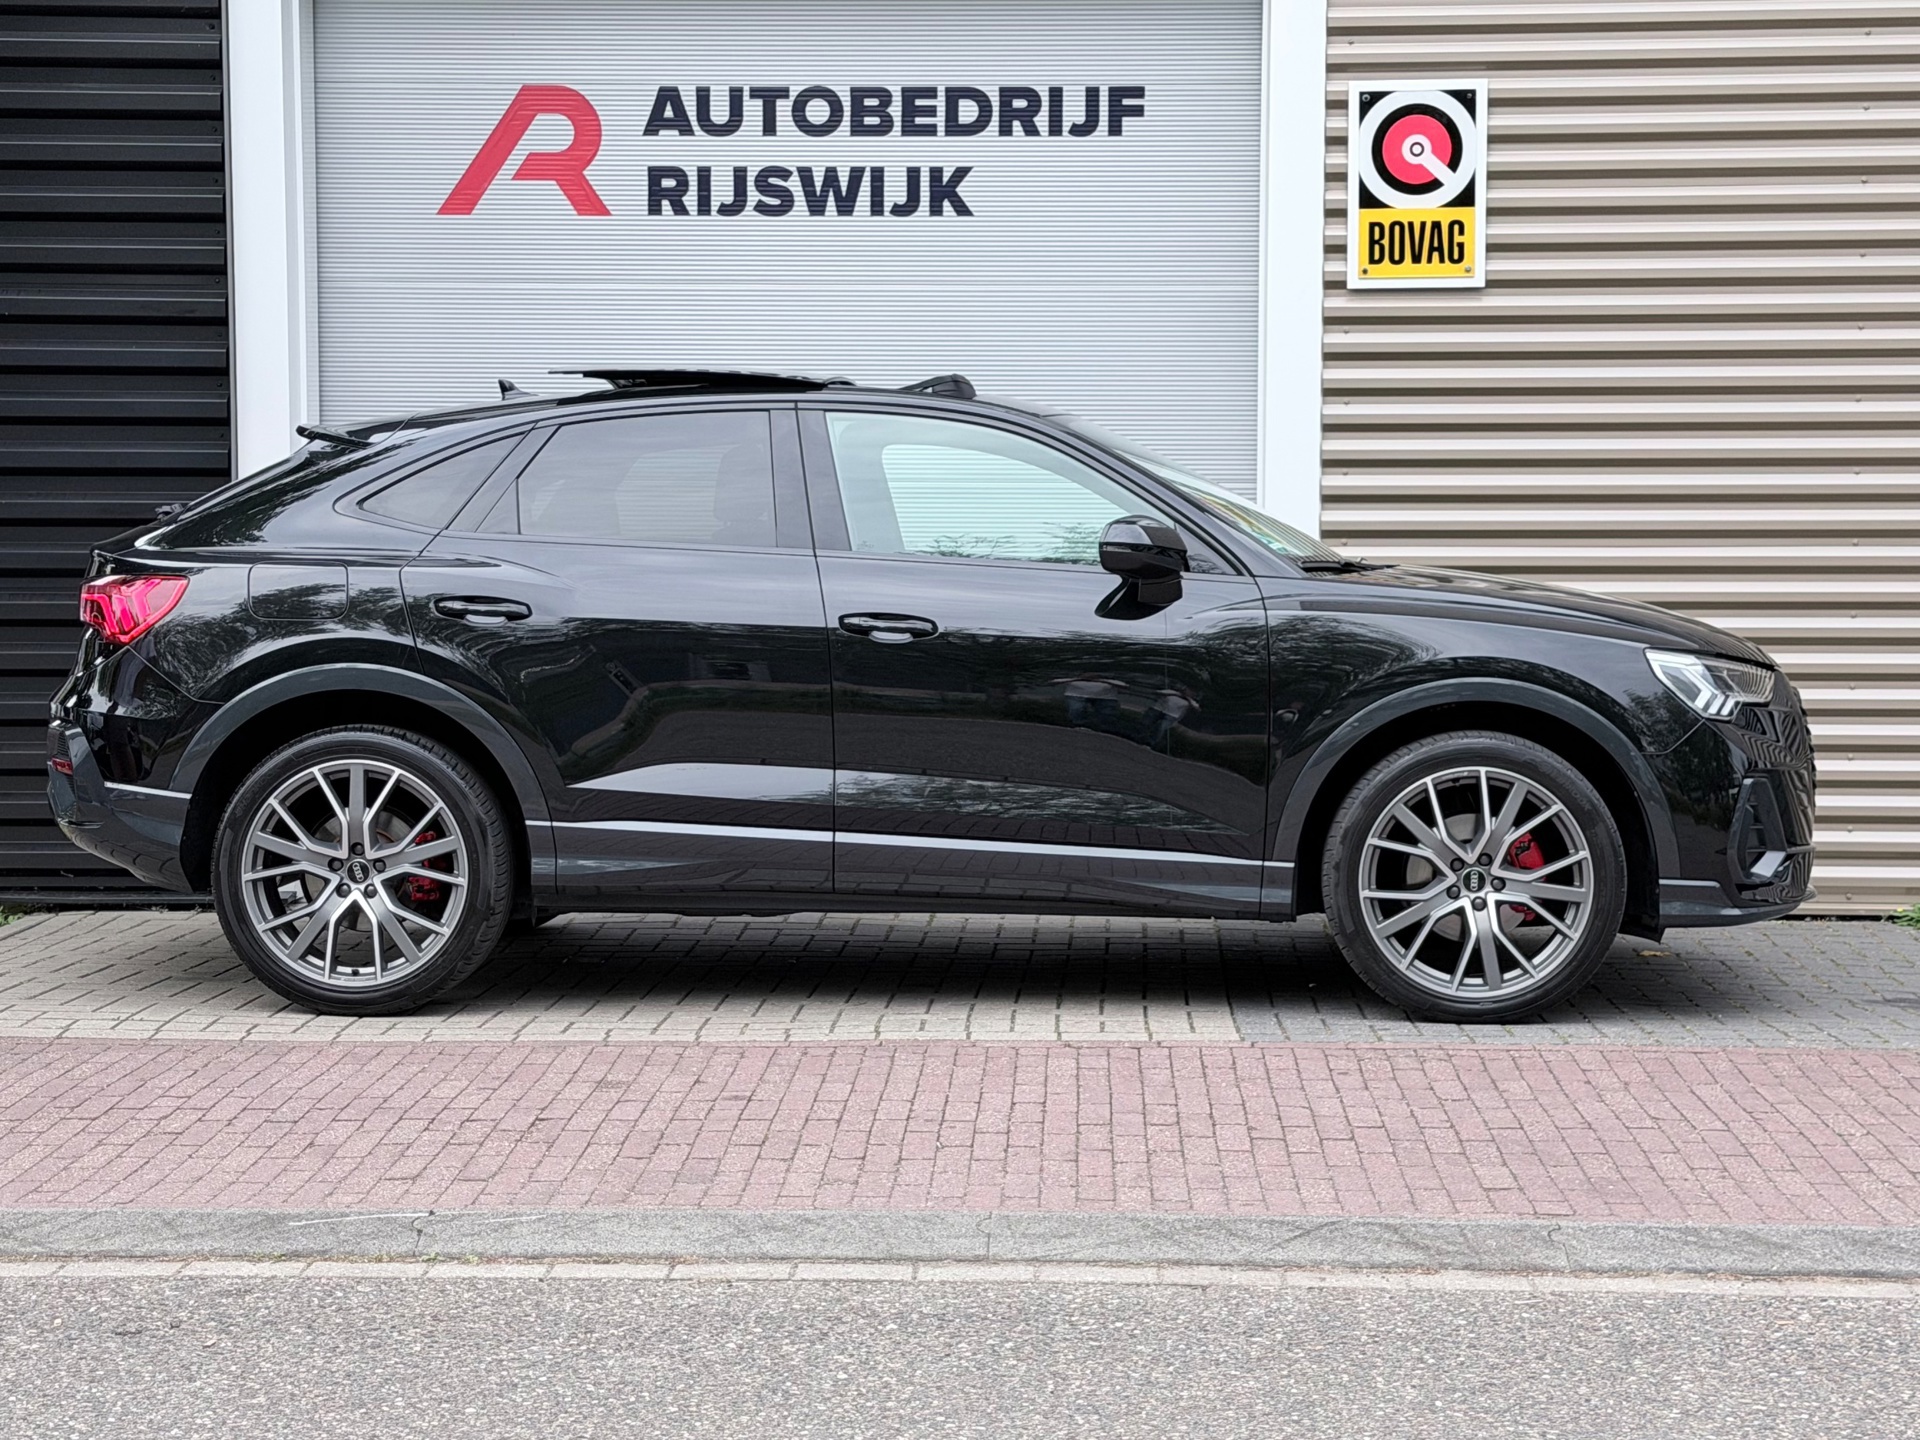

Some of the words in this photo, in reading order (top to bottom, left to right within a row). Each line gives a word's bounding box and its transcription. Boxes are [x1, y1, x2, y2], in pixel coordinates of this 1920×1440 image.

[642, 85, 1146, 138] AUTOBEDRIJF
[647, 165, 974, 217] RIJSWIJK
[1367, 219, 1466, 266] BOVAG
